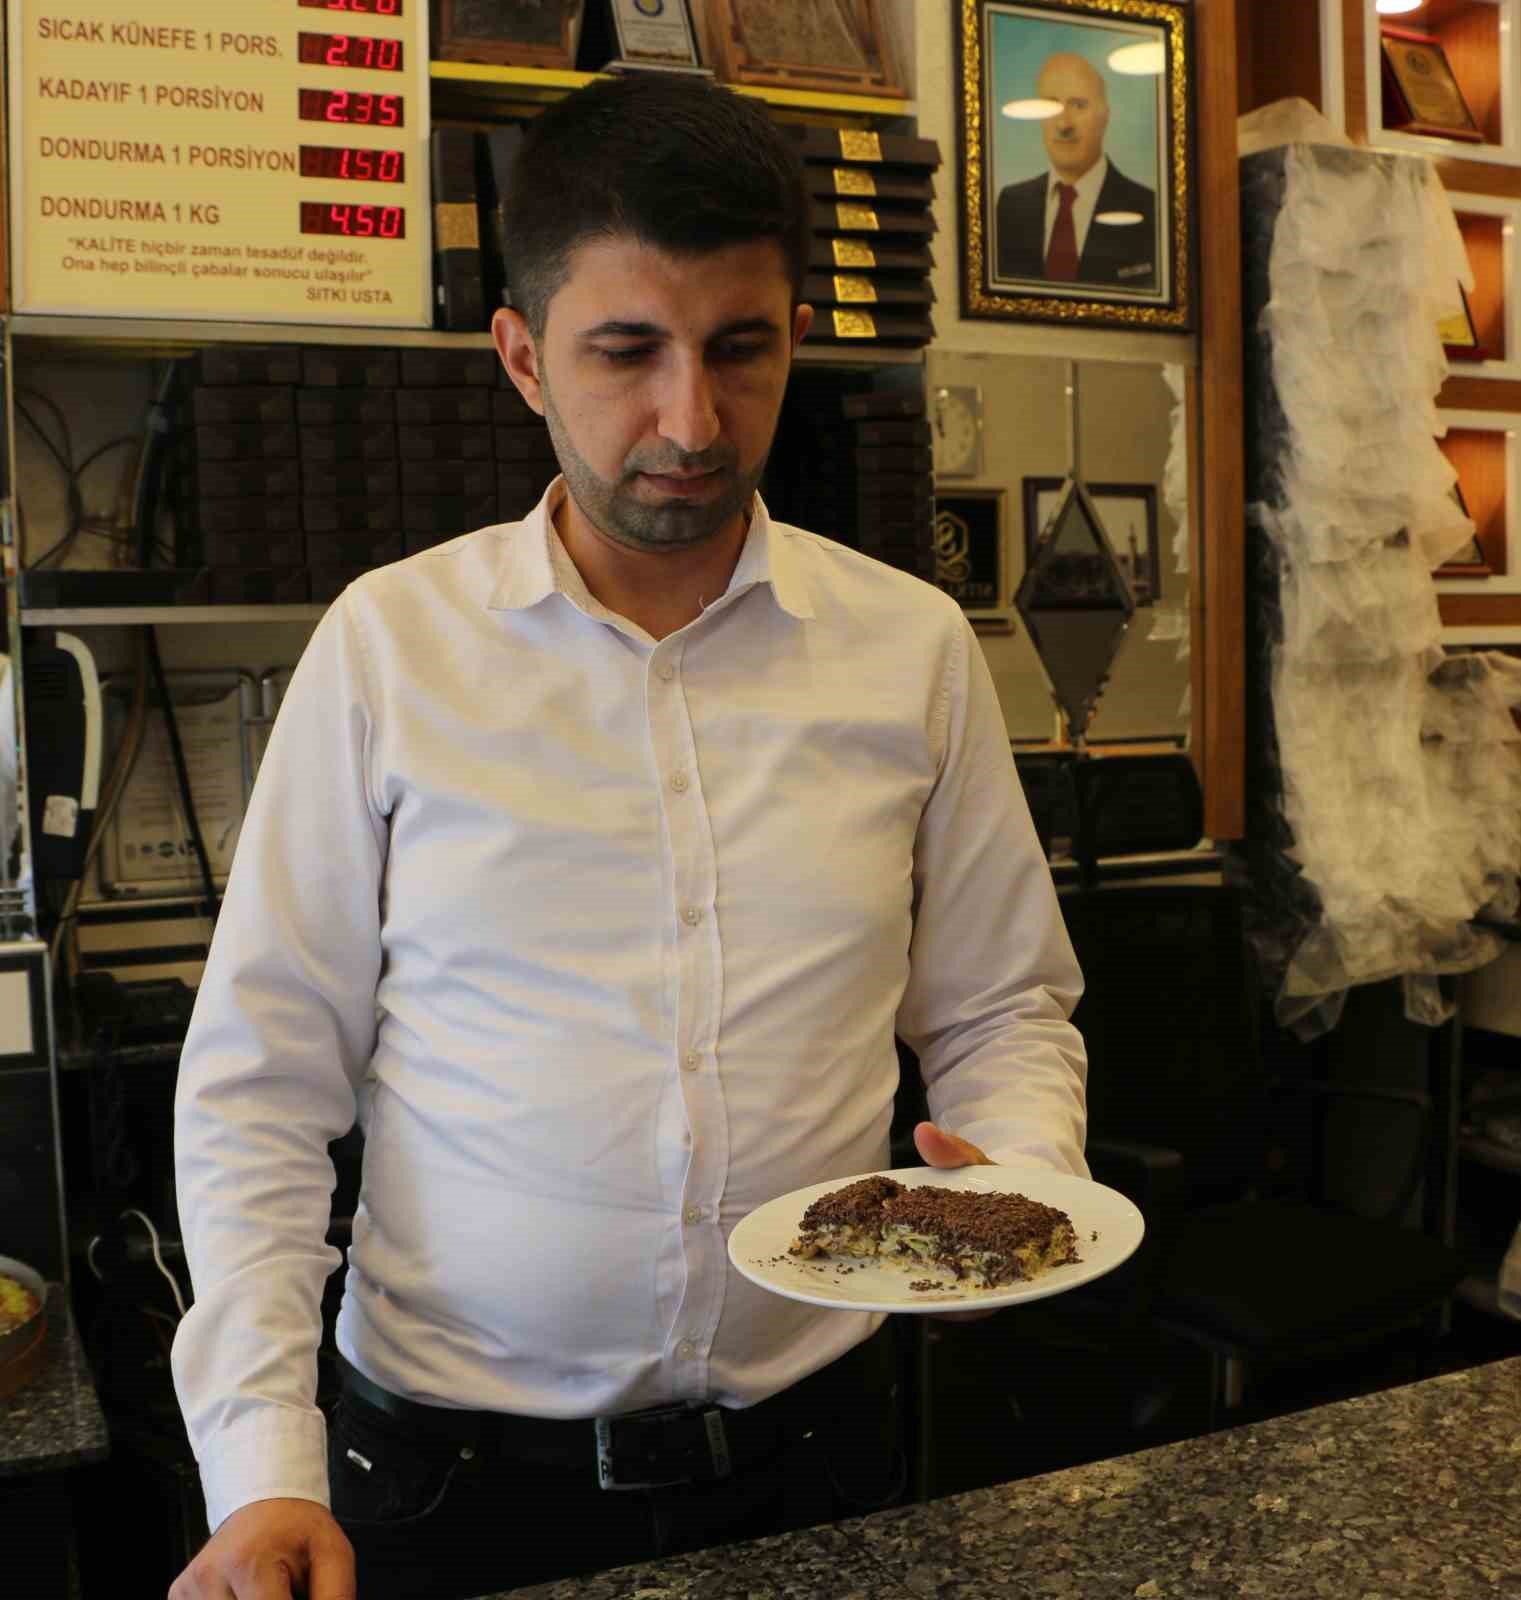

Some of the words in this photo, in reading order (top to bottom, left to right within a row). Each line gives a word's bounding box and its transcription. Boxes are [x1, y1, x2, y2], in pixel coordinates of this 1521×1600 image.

[39, 18, 105, 42] SICAK
[112, 21, 196, 50] KÜNEFE
[204, 32, 213, 51] 1
[221, 32, 283, 57] PORS.
[326, 34, 398, 69] 2.70
[39, 77, 131, 104] KADAYIF
[140, 85, 147, 105] 1
[157, 84, 263, 113] PORSİYON
[326, 90, 398, 124] 2.35
[40, 136, 166, 163] DONDURMA
[171, 145, 180, 165] 1
[189, 144, 296, 171] PORSİYON
[40, 196, 167, 222] DONDURMA
[173, 203, 181, 223] 1
[190, 204, 220, 225] KG
[62, 255, 96, 270] Ona
[101, 258, 129, 276] hep
[192, 261, 247, 278] çabalar
[253, 266, 310, 280] sonucu
[191, 244, 241, 257] zaman
[246, 245, 304, 261] tesadüf
[351, 289, 393, 304] USTA
